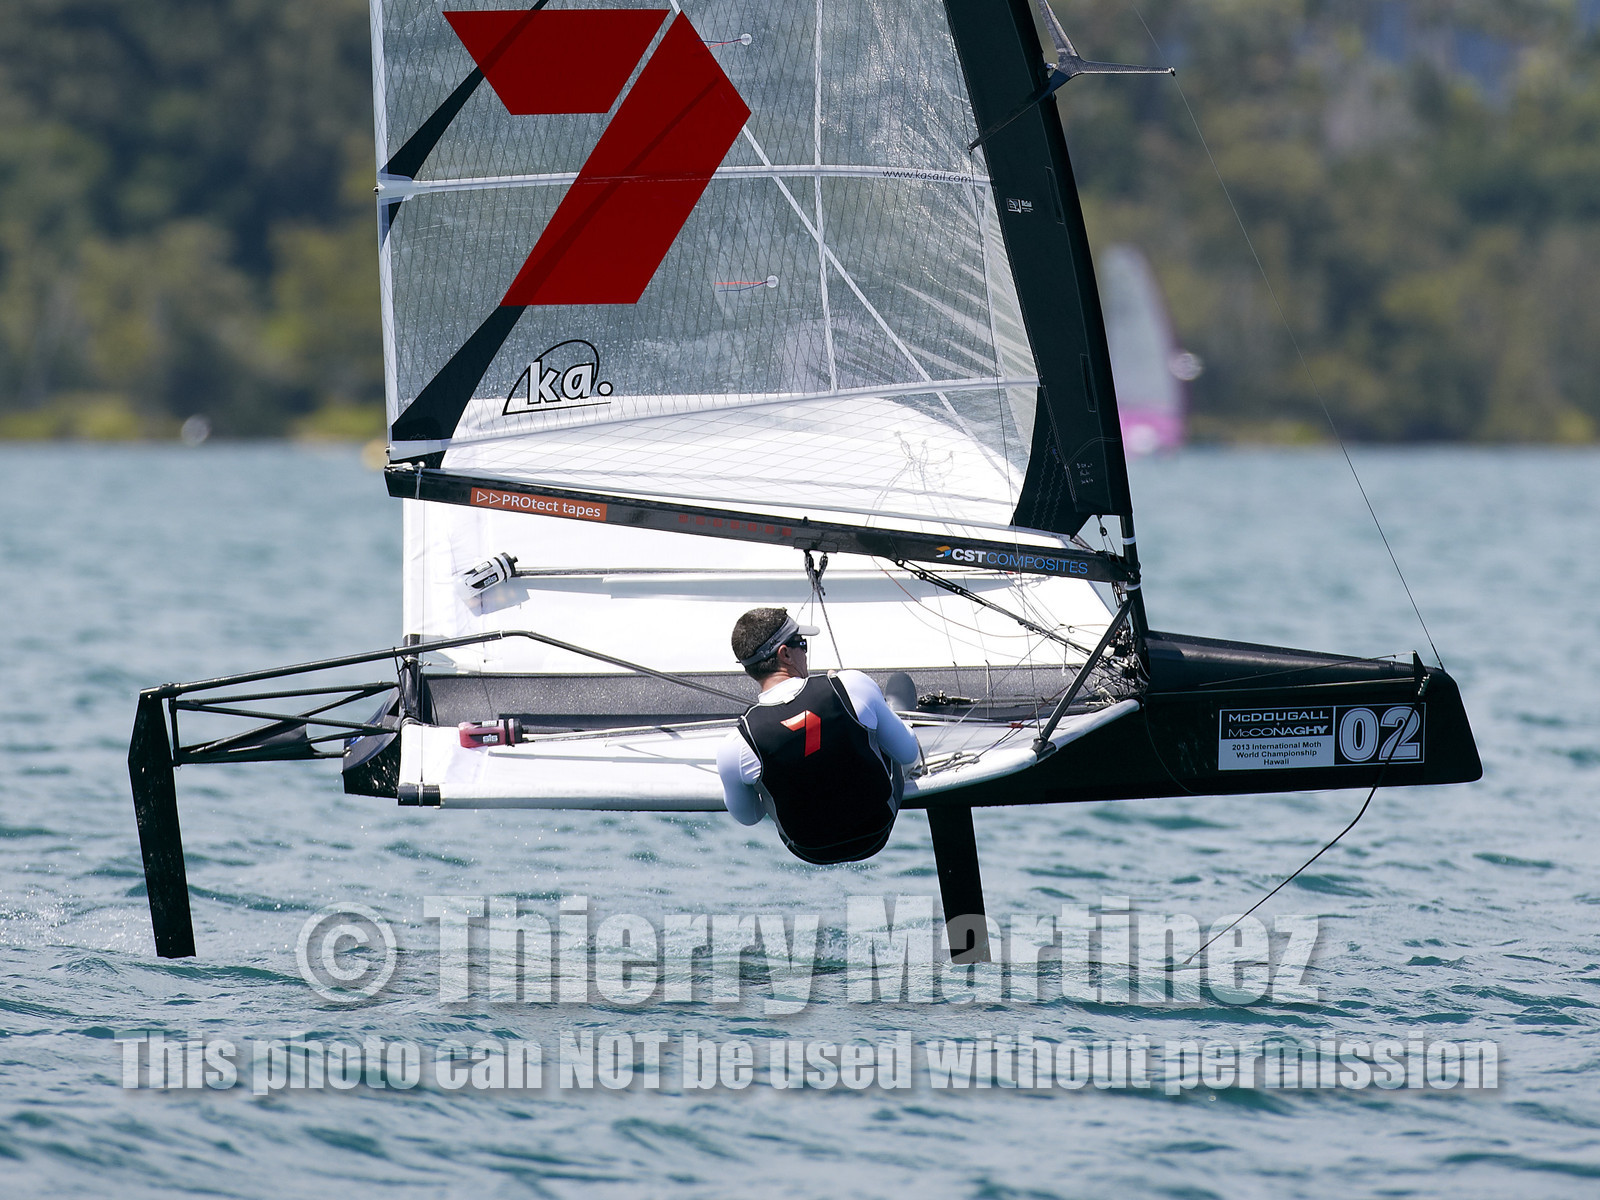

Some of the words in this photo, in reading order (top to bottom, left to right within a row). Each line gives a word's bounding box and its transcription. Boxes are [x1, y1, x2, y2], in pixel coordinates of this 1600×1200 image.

[882, 170, 972, 183] www.kasail.com
[502, 494, 558, 512] PROtect
[562, 502, 601, 517] tapes
[1339, 706, 1421, 763] 02
[1232, 743, 1250, 751] 2013
[1252, 741, 1300, 750] International
[1236, 750, 1259, 758] World
[1261, 749, 1317, 757] Championship
